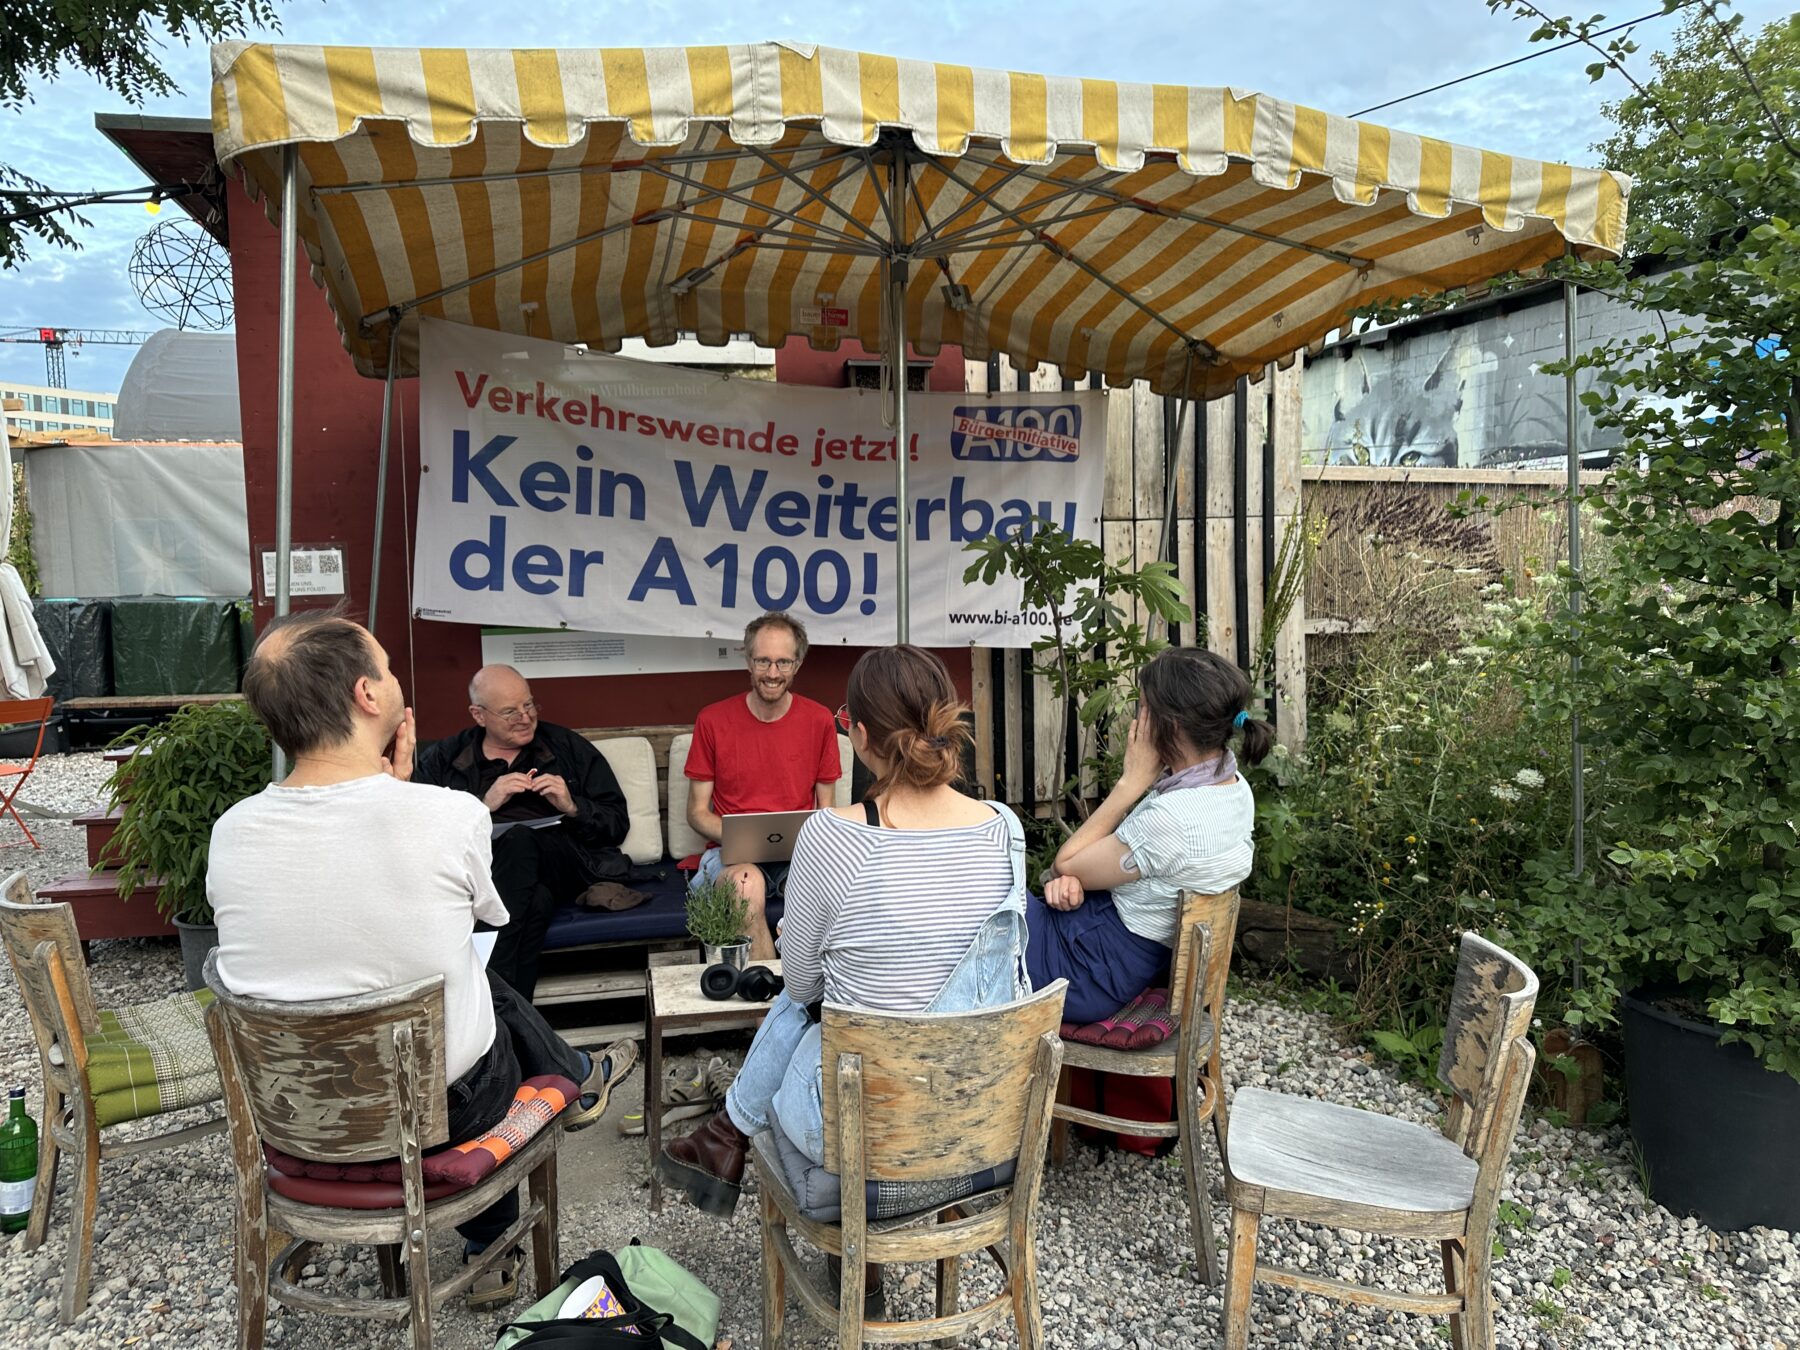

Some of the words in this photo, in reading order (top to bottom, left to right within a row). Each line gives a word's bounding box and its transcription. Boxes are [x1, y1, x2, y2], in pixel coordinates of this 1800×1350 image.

[454, 370, 799, 456] Verkehrswende
[811, 428, 919, 467] jetzt!
[958, 418, 1077, 453] Bürgerinitiative
[452, 429, 646, 521] Kein
[674, 460, 1077, 544] Weiterbau
[449, 515, 604, 595] der
[627, 536, 878, 616] A100!
